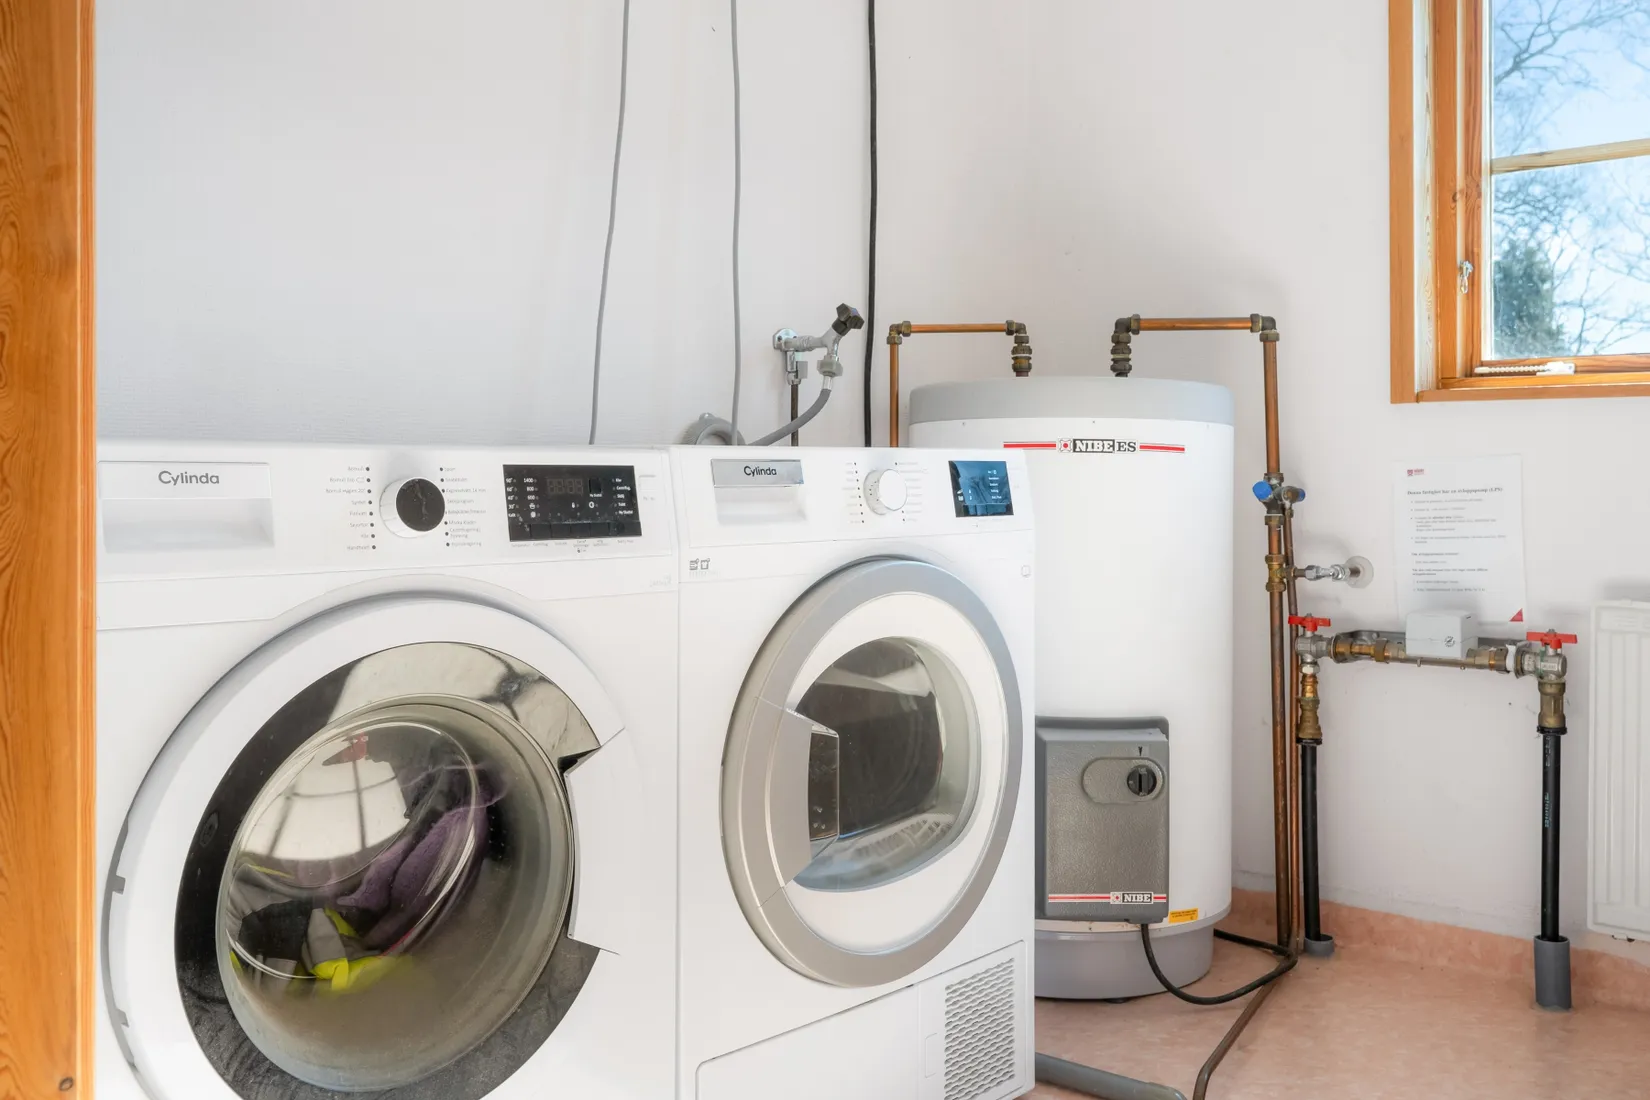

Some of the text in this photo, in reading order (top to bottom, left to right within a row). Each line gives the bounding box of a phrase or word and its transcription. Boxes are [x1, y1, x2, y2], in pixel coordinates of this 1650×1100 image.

[1074, 439, 1137, 452] NIBE ES
[743, 465, 777, 477] Cylinda
[158, 470, 220, 486] Cylinda
[1123, 893, 1151, 903] NIBE
